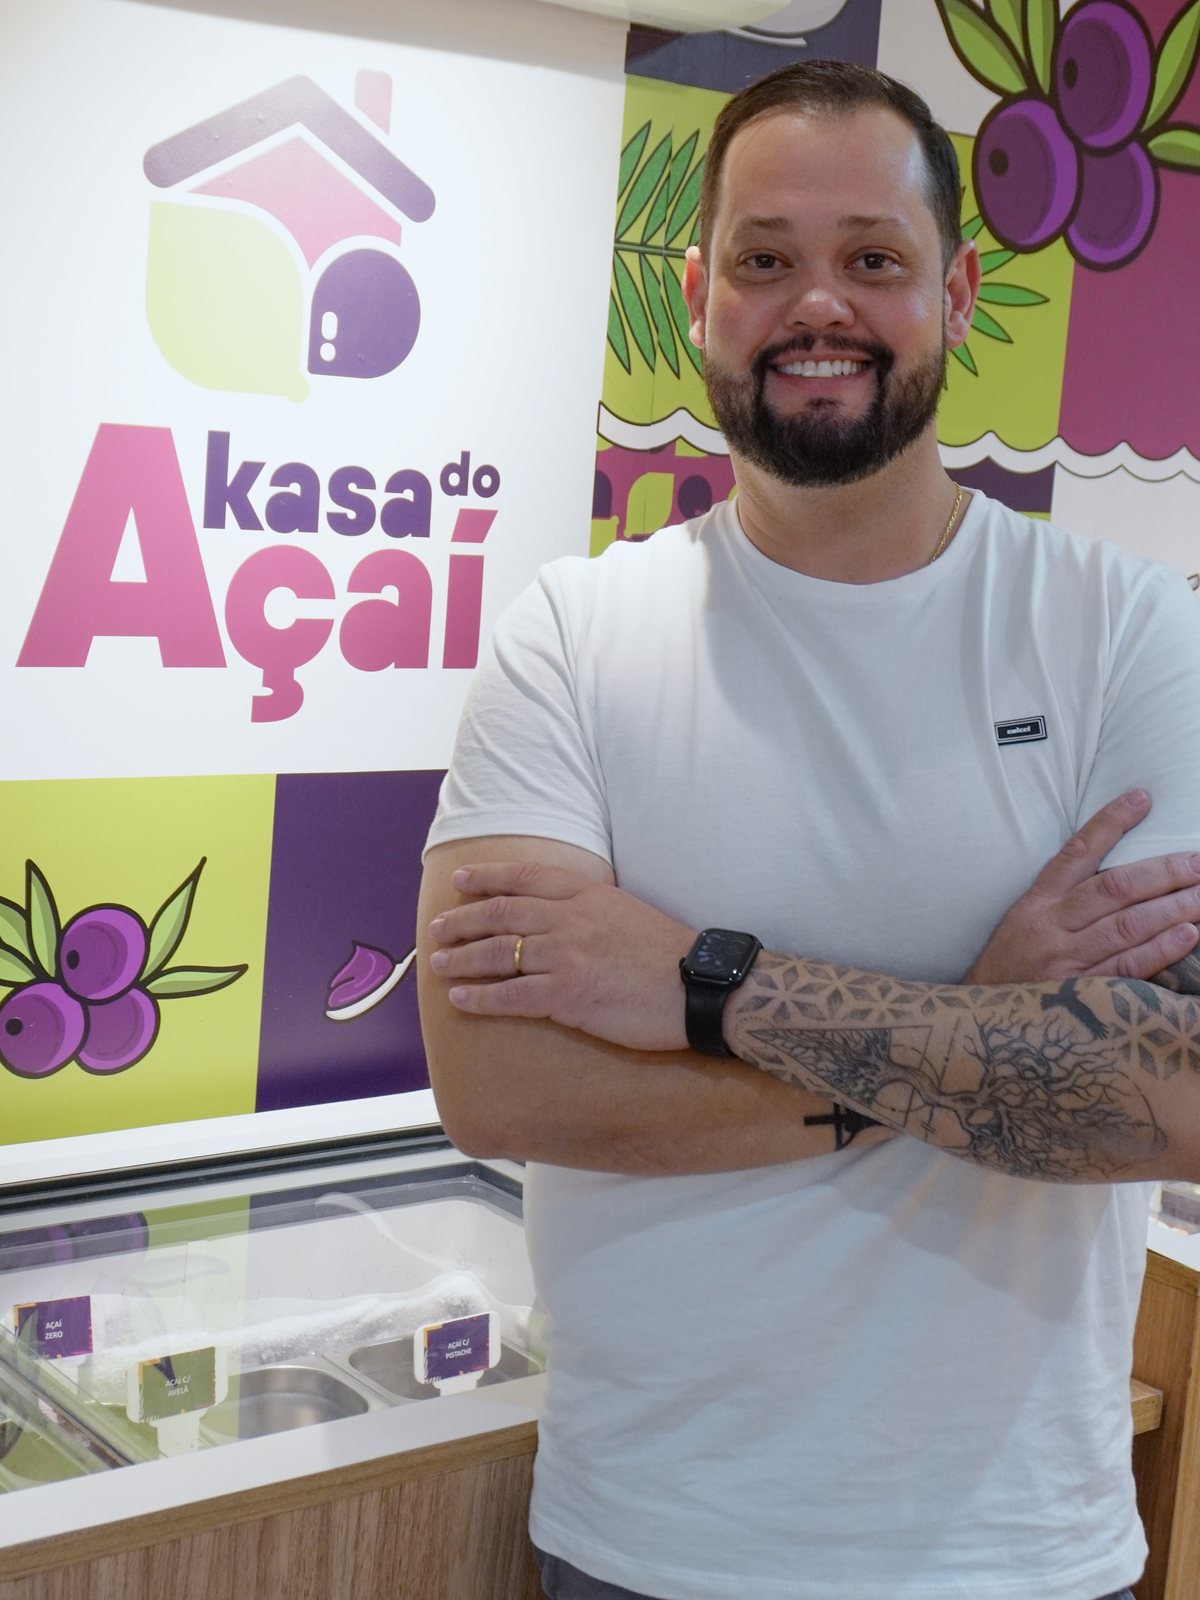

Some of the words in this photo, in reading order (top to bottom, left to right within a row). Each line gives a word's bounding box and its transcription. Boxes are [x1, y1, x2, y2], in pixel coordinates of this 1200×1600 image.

[203, 430, 433, 538] kasa
[439, 450, 501, 498] do
[15, 422, 499, 723] Açaí
[45, 1319, 62, 1330] AÇAÍ
[45, 1331, 63, 1340] ZERO
[445, 1348, 472, 1359] PISTACHE
